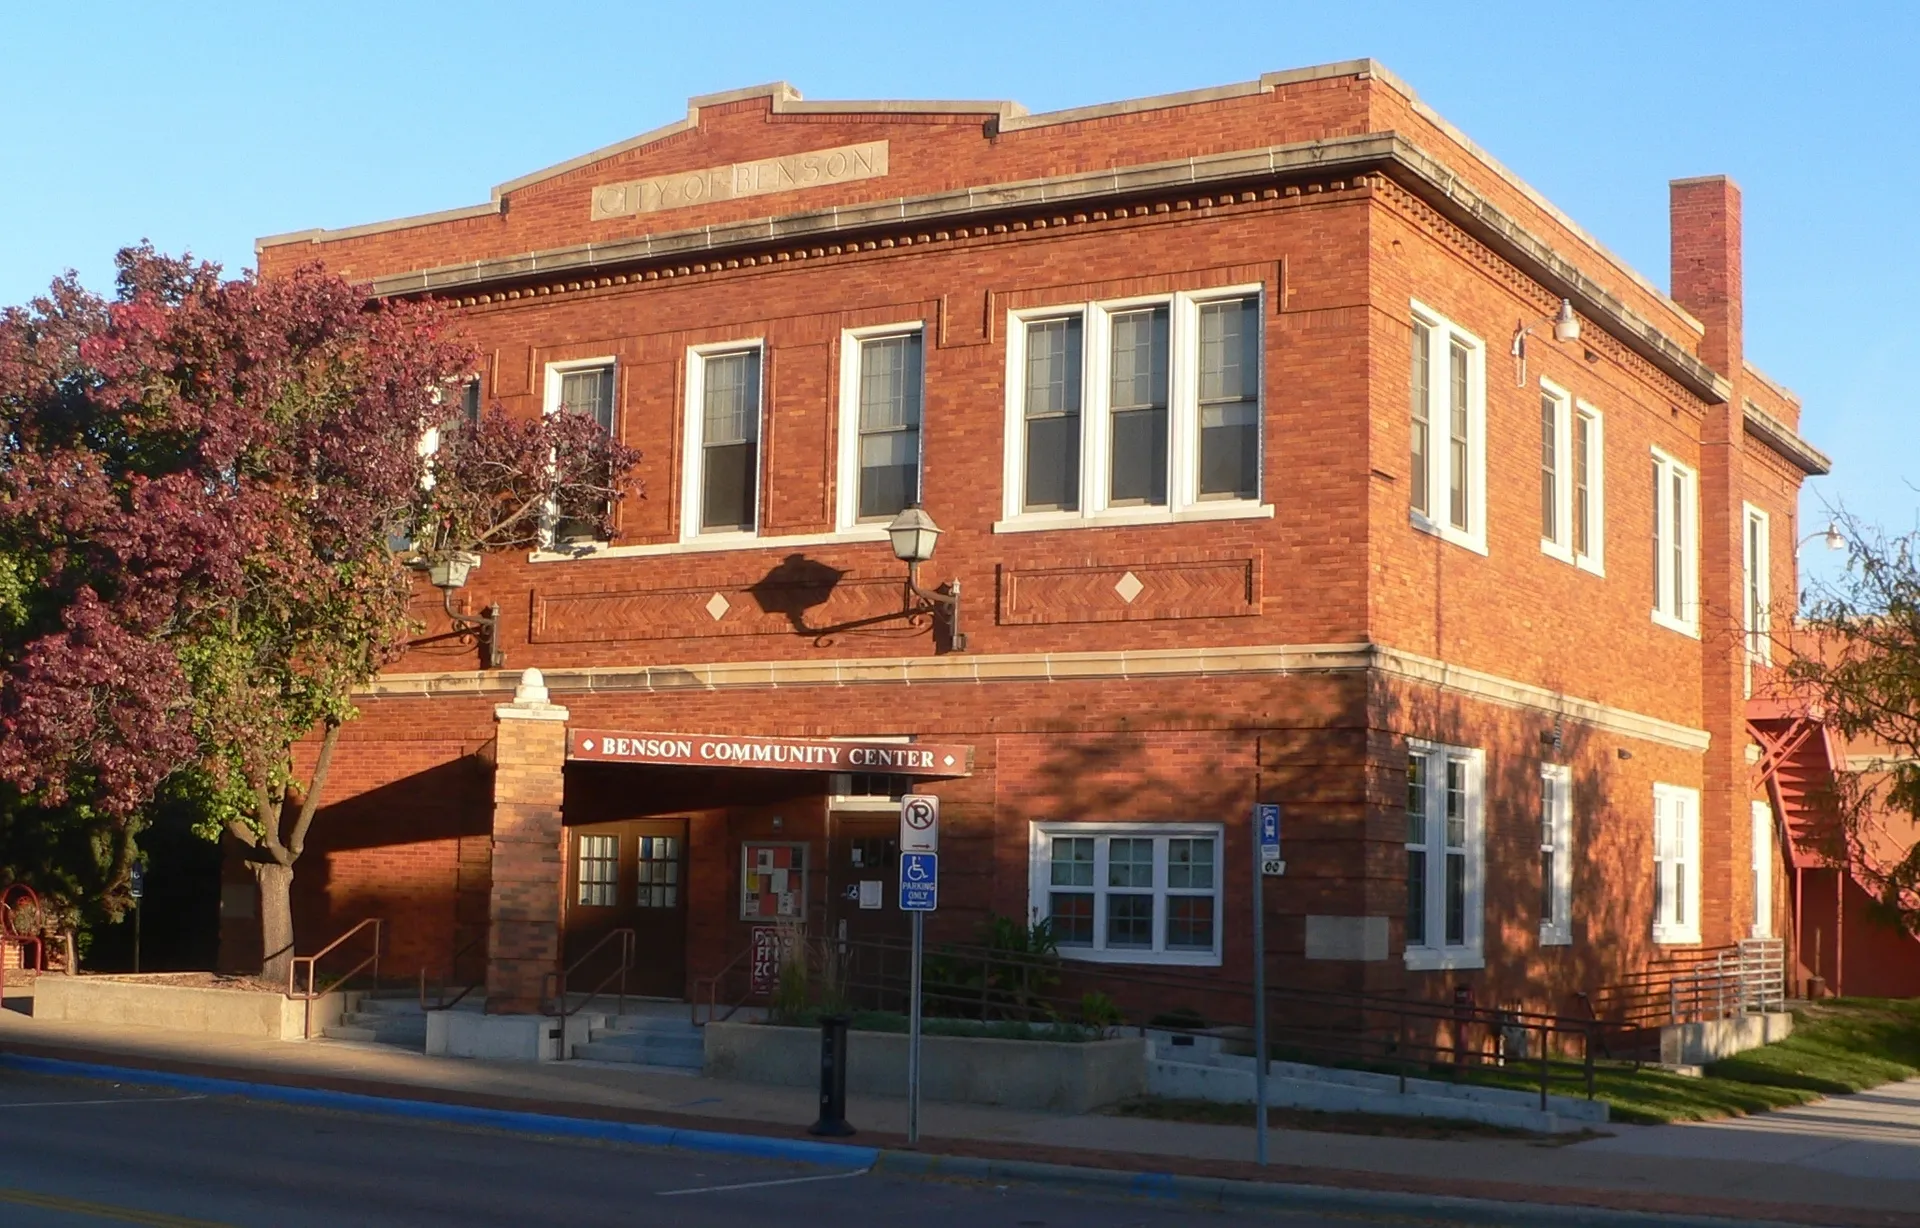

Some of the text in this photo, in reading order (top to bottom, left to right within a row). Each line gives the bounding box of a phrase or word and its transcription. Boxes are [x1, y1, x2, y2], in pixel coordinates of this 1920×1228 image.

[599, 180, 670, 214] CITY
[684, 172, 723, 201] OF
[602, 737, 934, 768] BENSON COMMUNITY CENTER
[902, 881, 936, 891] PARKING
[908, 891, 929, 900] ONLY
